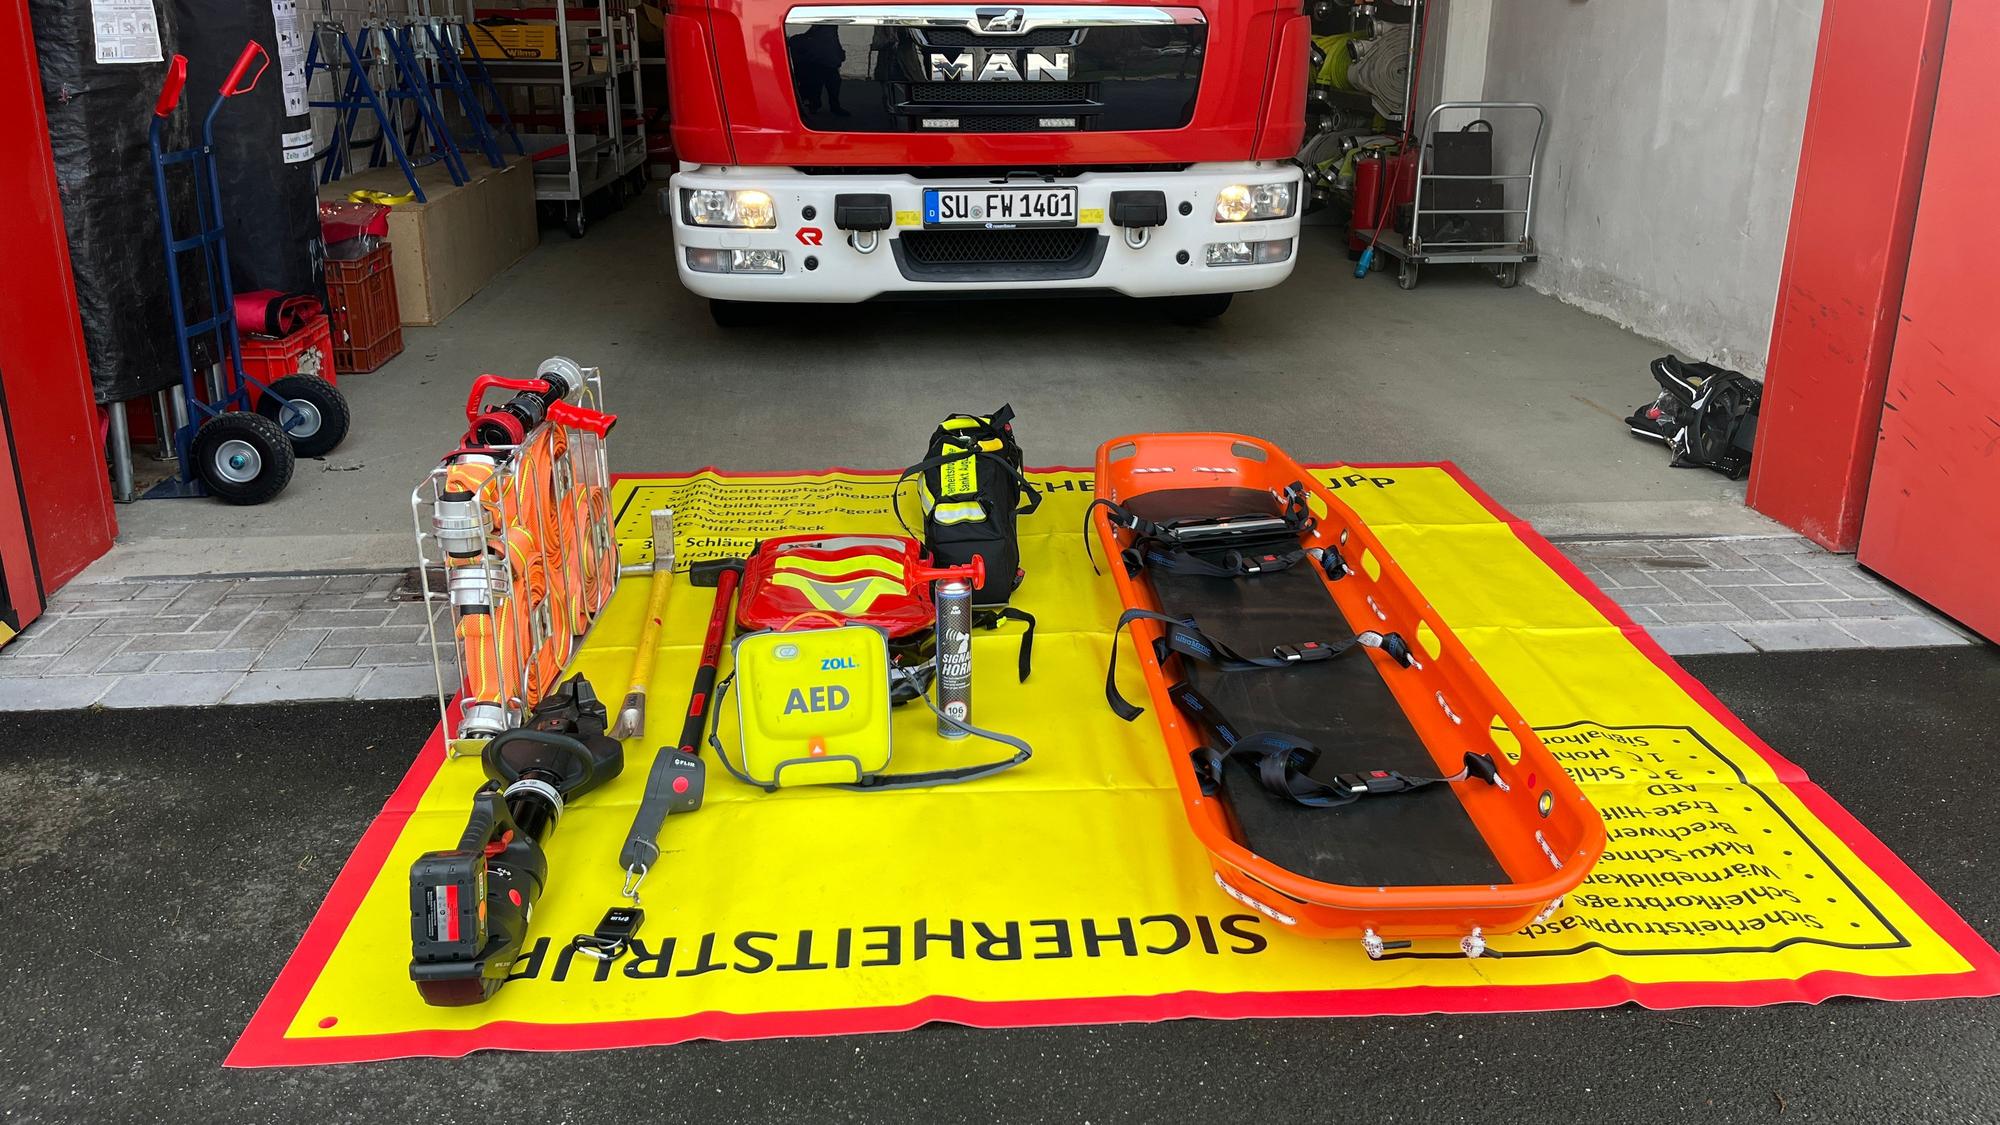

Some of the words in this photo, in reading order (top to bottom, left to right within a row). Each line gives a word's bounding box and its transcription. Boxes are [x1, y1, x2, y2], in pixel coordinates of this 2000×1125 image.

[930, 53, 1069, 81] MAN
[941, 195, 968, 218] SU
[986, 194, 1013, 218] FW
[1020, 193, 1073, 217] 1401
[667, 490, 799, 501] Schleifkorbtrage
[816, 490, 907, 500] Spineboard
[672, 483, 853, 495] Sicherheitstrupptasche
[665, 498, 816, 509] Wärmebildkamera
[672, 505, 779, 516] kku-Schneid-
[796, 507, 890, 516] Spreizgerät
[642, 541, 653, 549] 3
[821, 657, 856, 671] ZOLL
[784, 685, 850, 715] AED
[948, 706, 964, 715] 106
[1543, 730, 1650, 747] Signalhor
[1647, 783, 1697, 796] AED
[1600, 800, 1720, 820] Erste-Hilf
[1574, 885, 1801, 910] Schleifkorbtrage
[1518, 909, 1824, 939] Sicherheitstrupptasch
[505, 914, 1268, 982] SICHERHEITSTRUP
